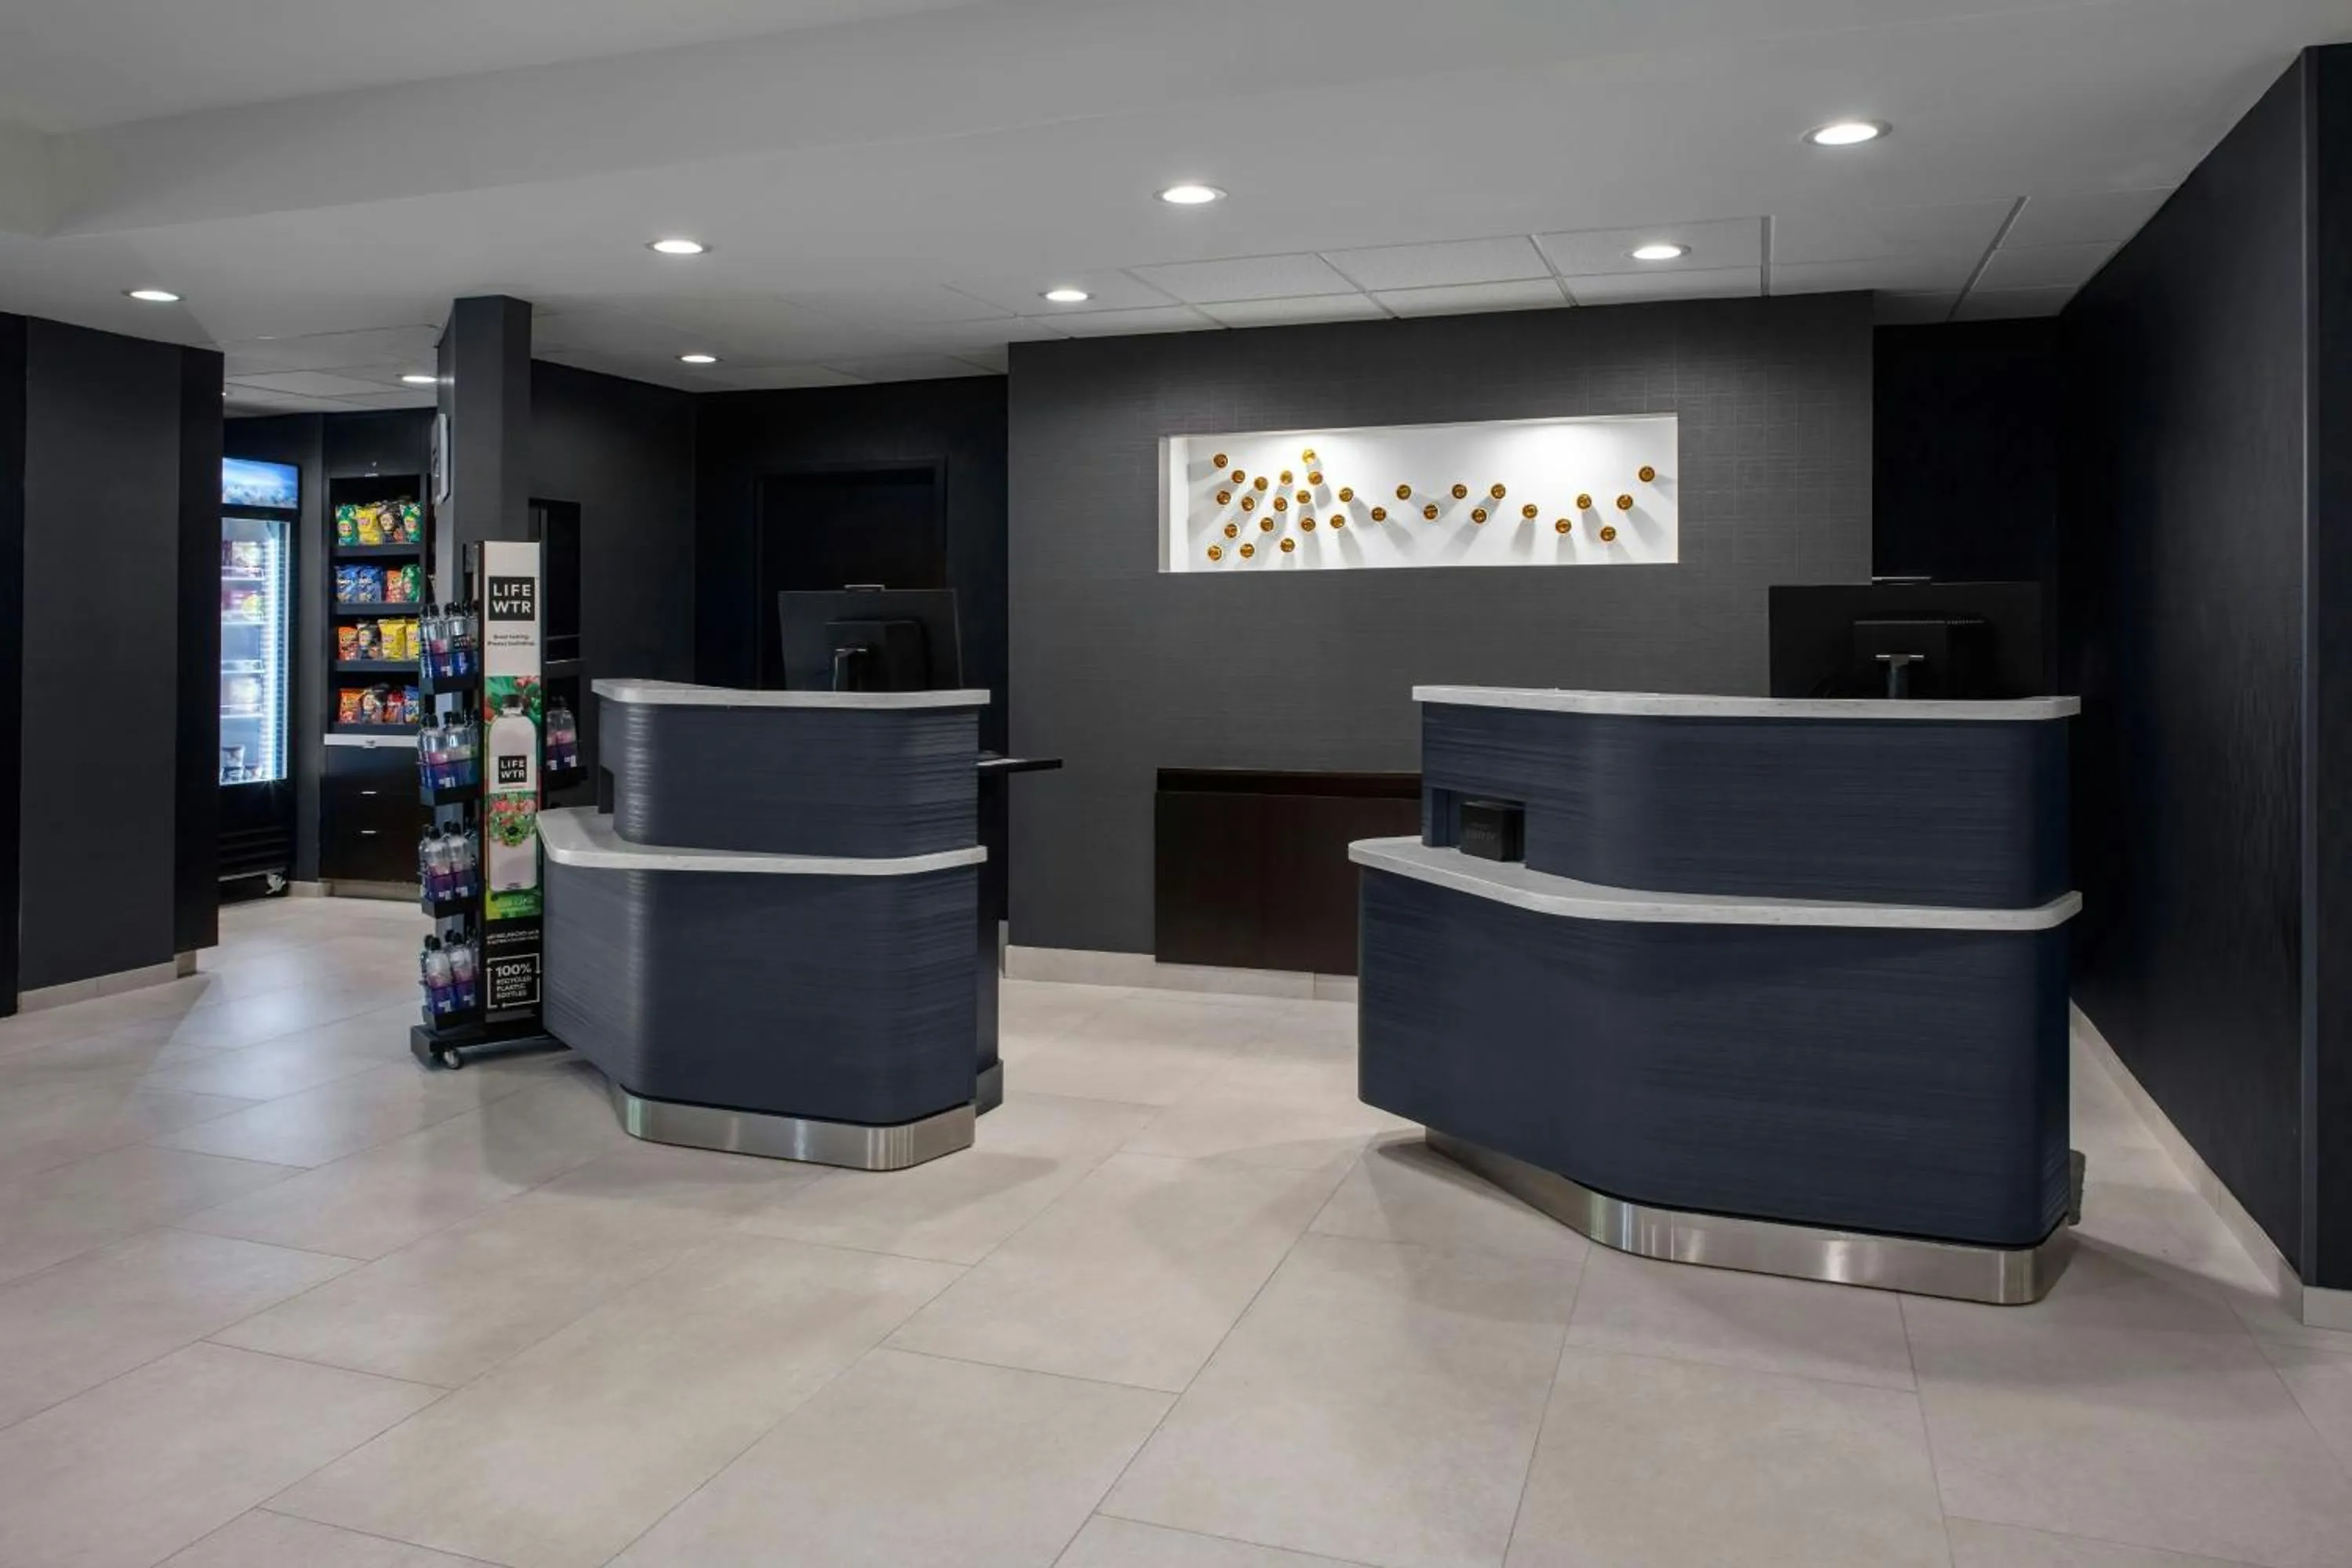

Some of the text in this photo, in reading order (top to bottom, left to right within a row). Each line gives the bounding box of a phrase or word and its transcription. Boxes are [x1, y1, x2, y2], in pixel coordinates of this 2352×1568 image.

[493, 583, 531, 597] LIFE
[492, 600, 531, 614] WTR
[501, 759, 524, 769] LIFE
[501, 769, 524, 779] WTR
[495, 964, 532, 977] 100%
